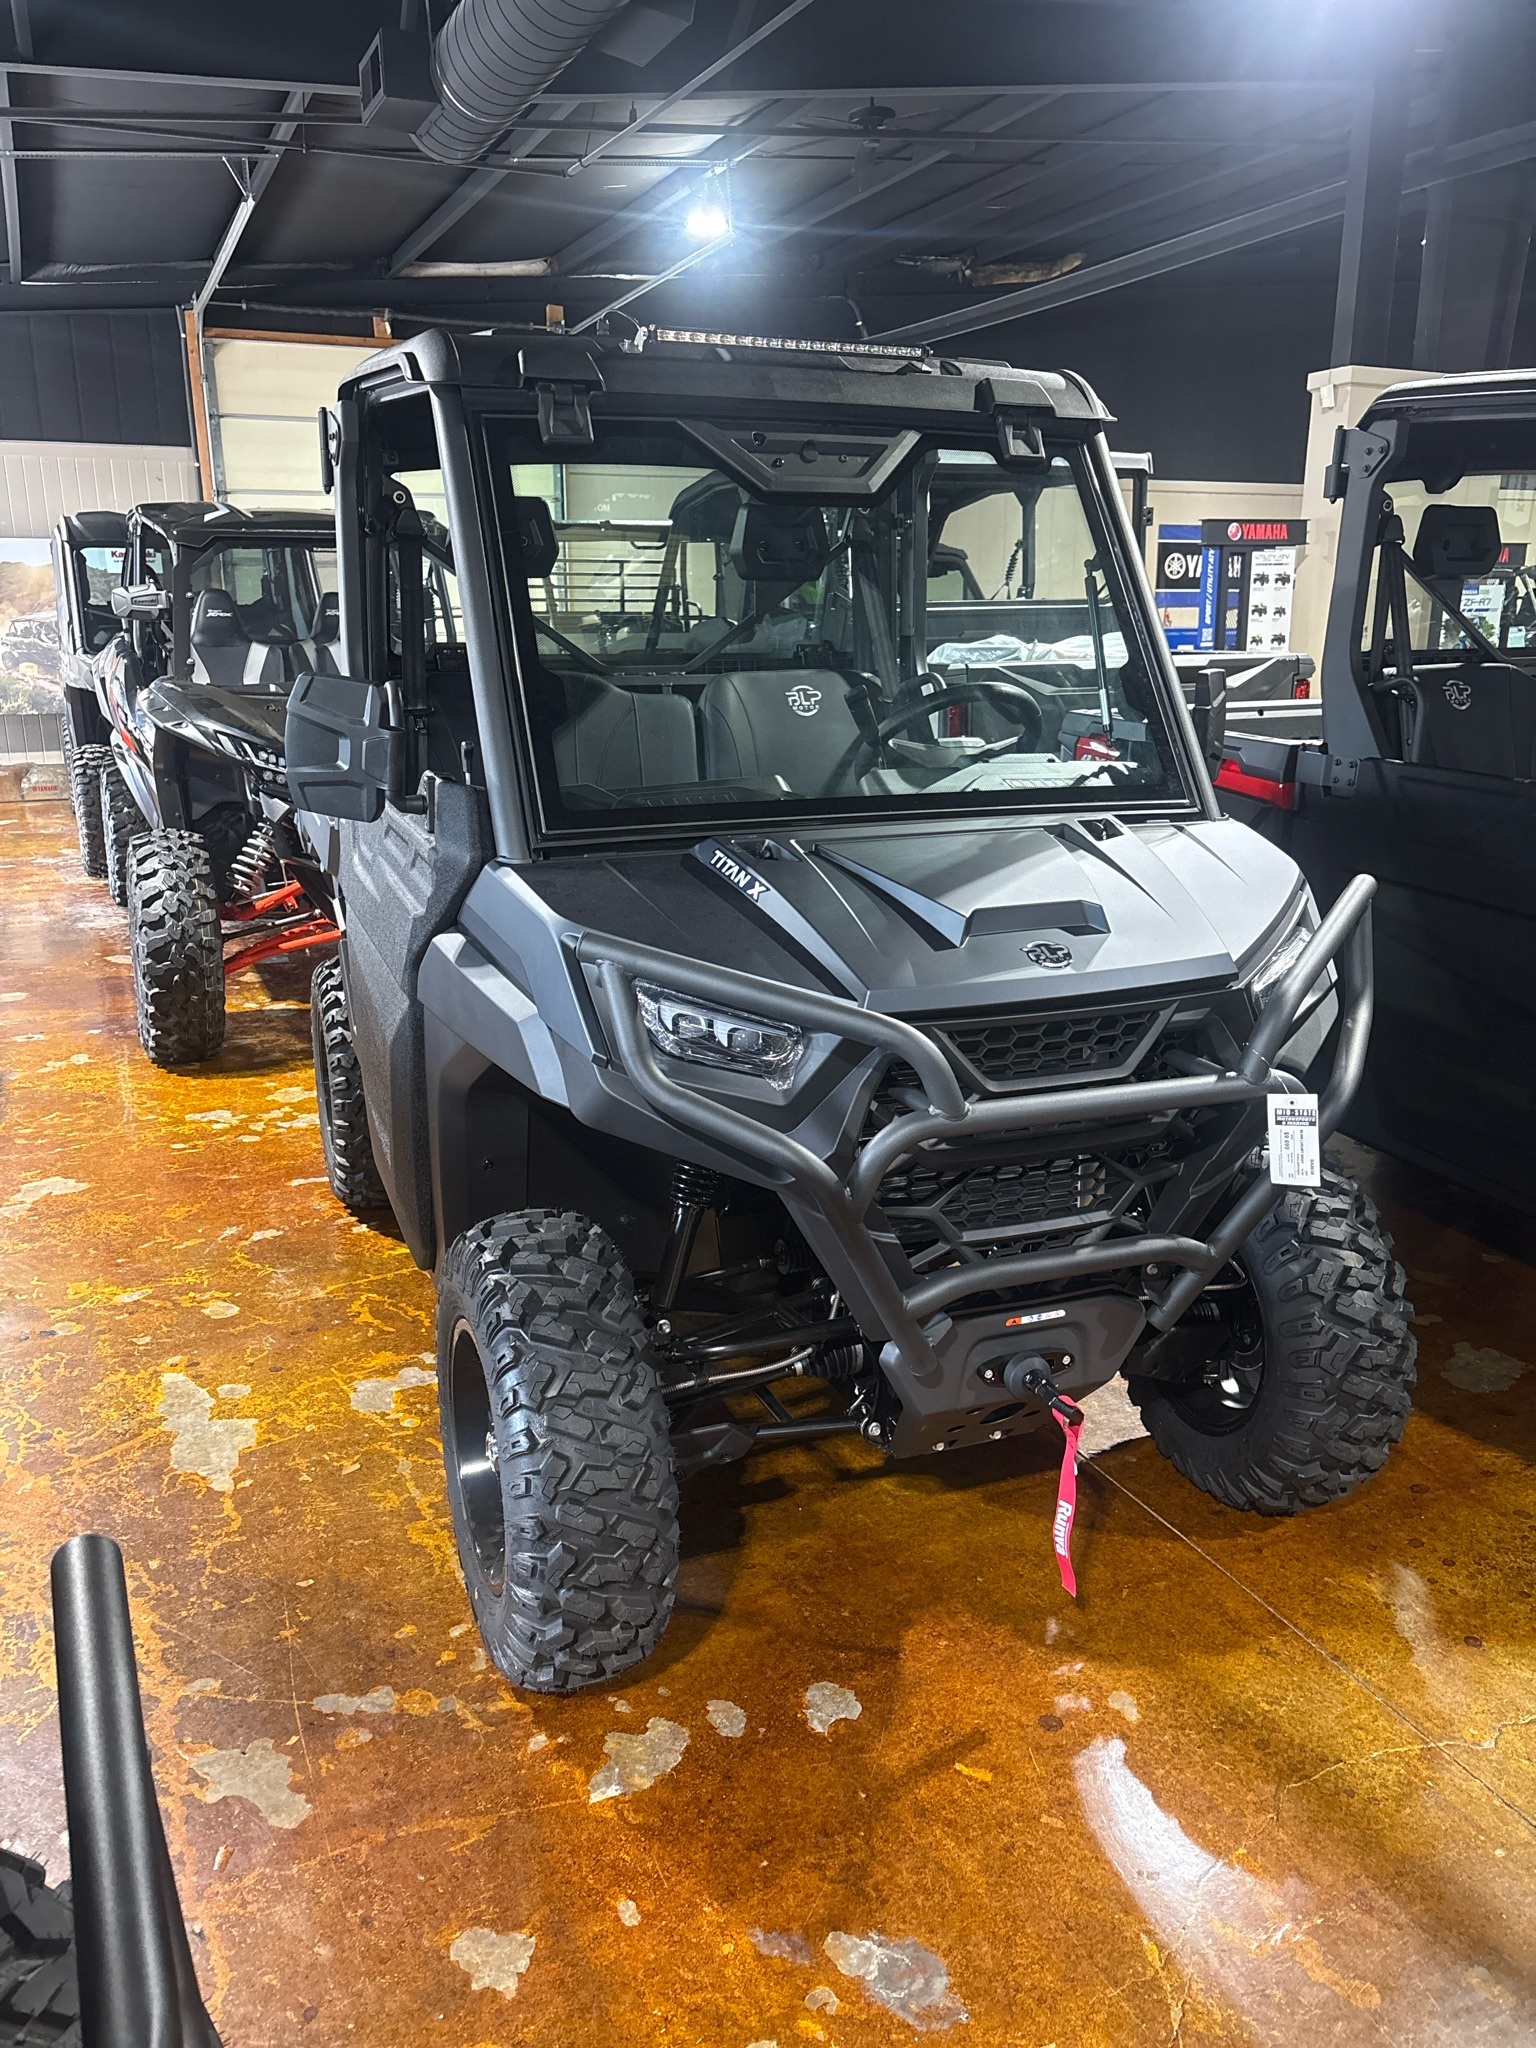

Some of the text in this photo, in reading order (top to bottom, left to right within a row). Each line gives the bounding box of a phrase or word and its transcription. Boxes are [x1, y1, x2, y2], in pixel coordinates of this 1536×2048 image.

[1242, 524, 1288, 540] YAMAHA
[1206, 564, 1214, 594] UTILITY
[785, 690, 822, 706] BLP
[710, 849, 767, 901] TITAN X
[1054, 1500, 1072, 1557] Runva
